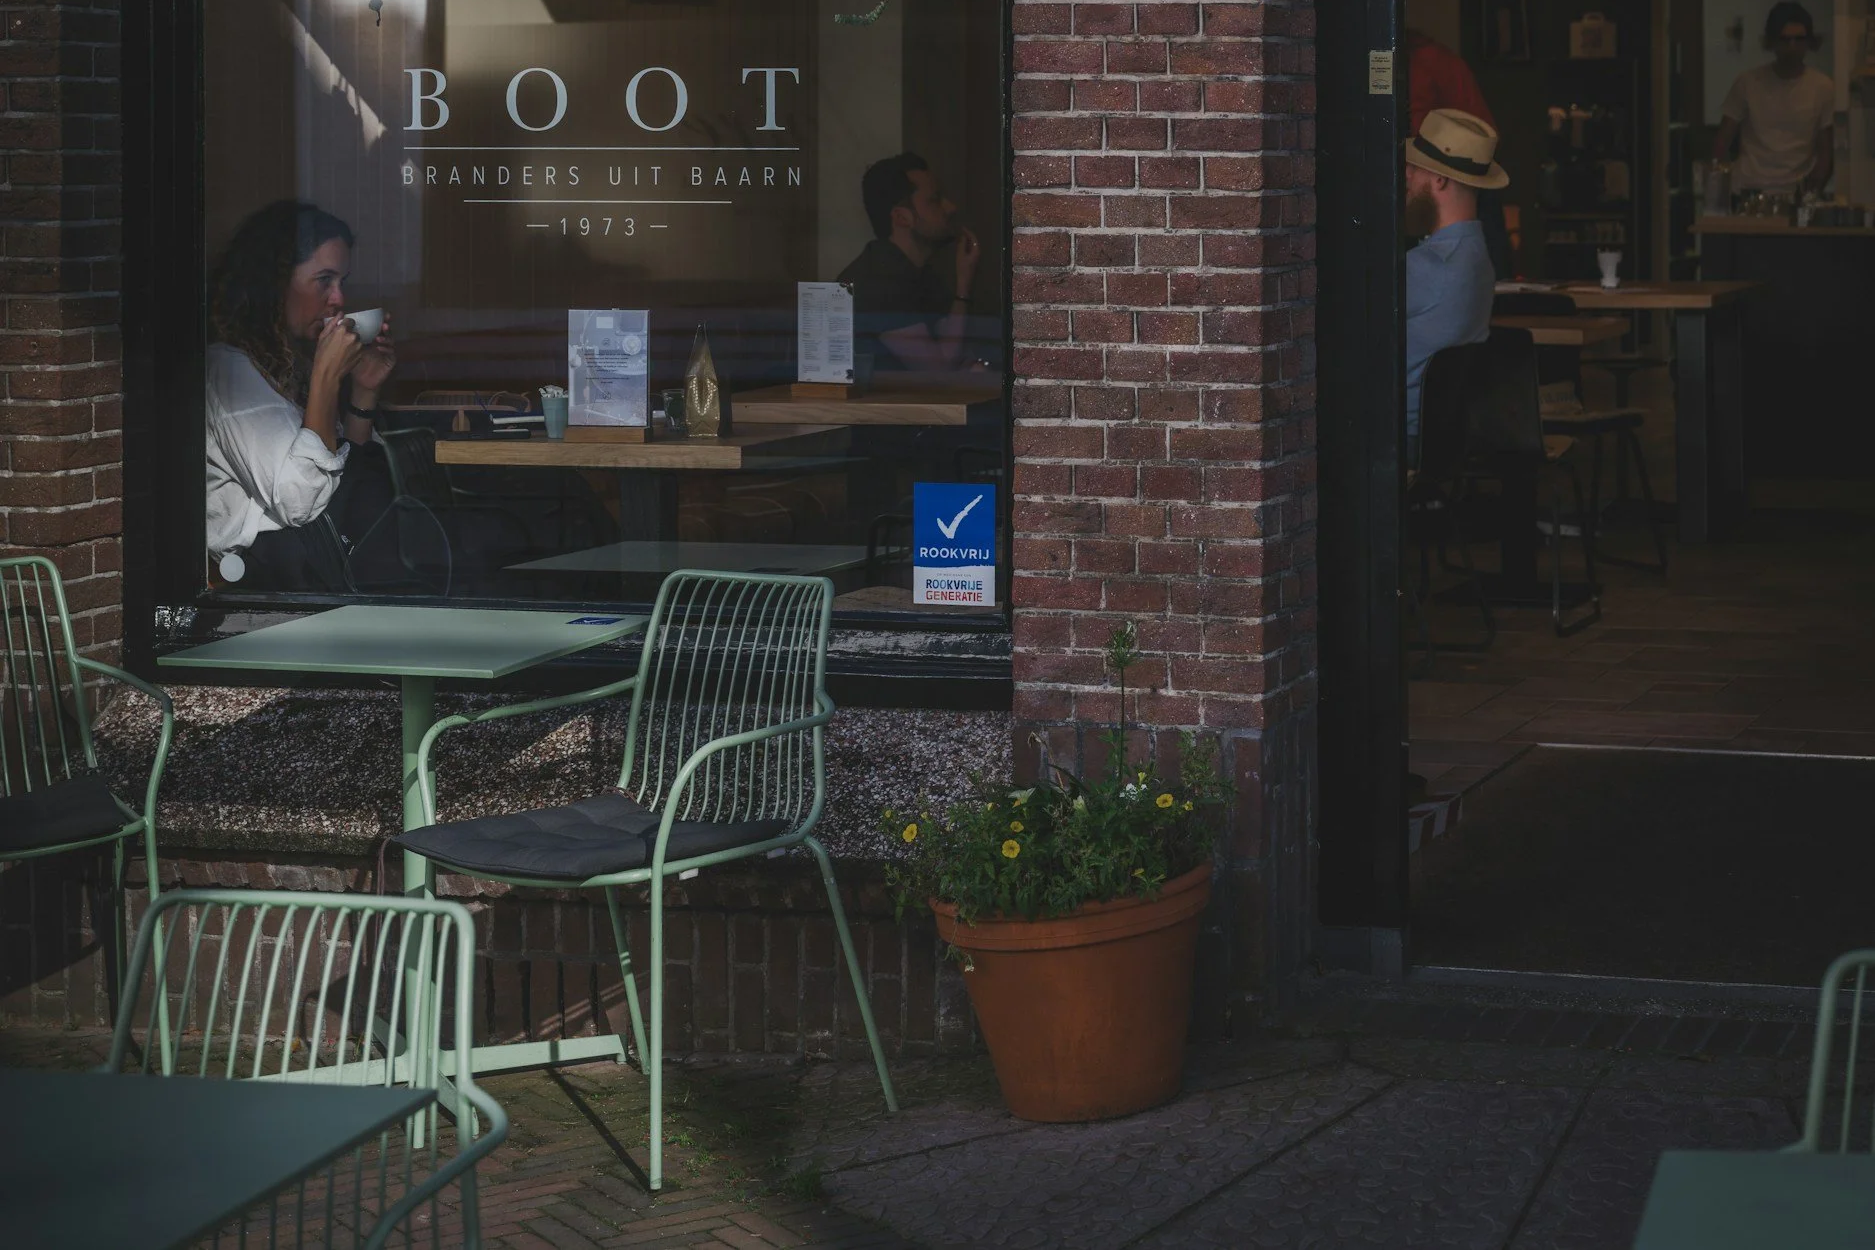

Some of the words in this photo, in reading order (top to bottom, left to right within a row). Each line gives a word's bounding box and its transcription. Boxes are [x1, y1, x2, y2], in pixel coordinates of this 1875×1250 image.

[403, 67, 800, 132] BOOT
[402, 165, 581, 186] BRANDERS
[608, 165, 663, 186] UIT
[690, 165, 801, 187] BAARN
[919, 547, 990, 560] ROOKVRIJ
[926, 579, 983, 590] ROOKVRIJE
[926, 591, 983, 602] GENERATIE
